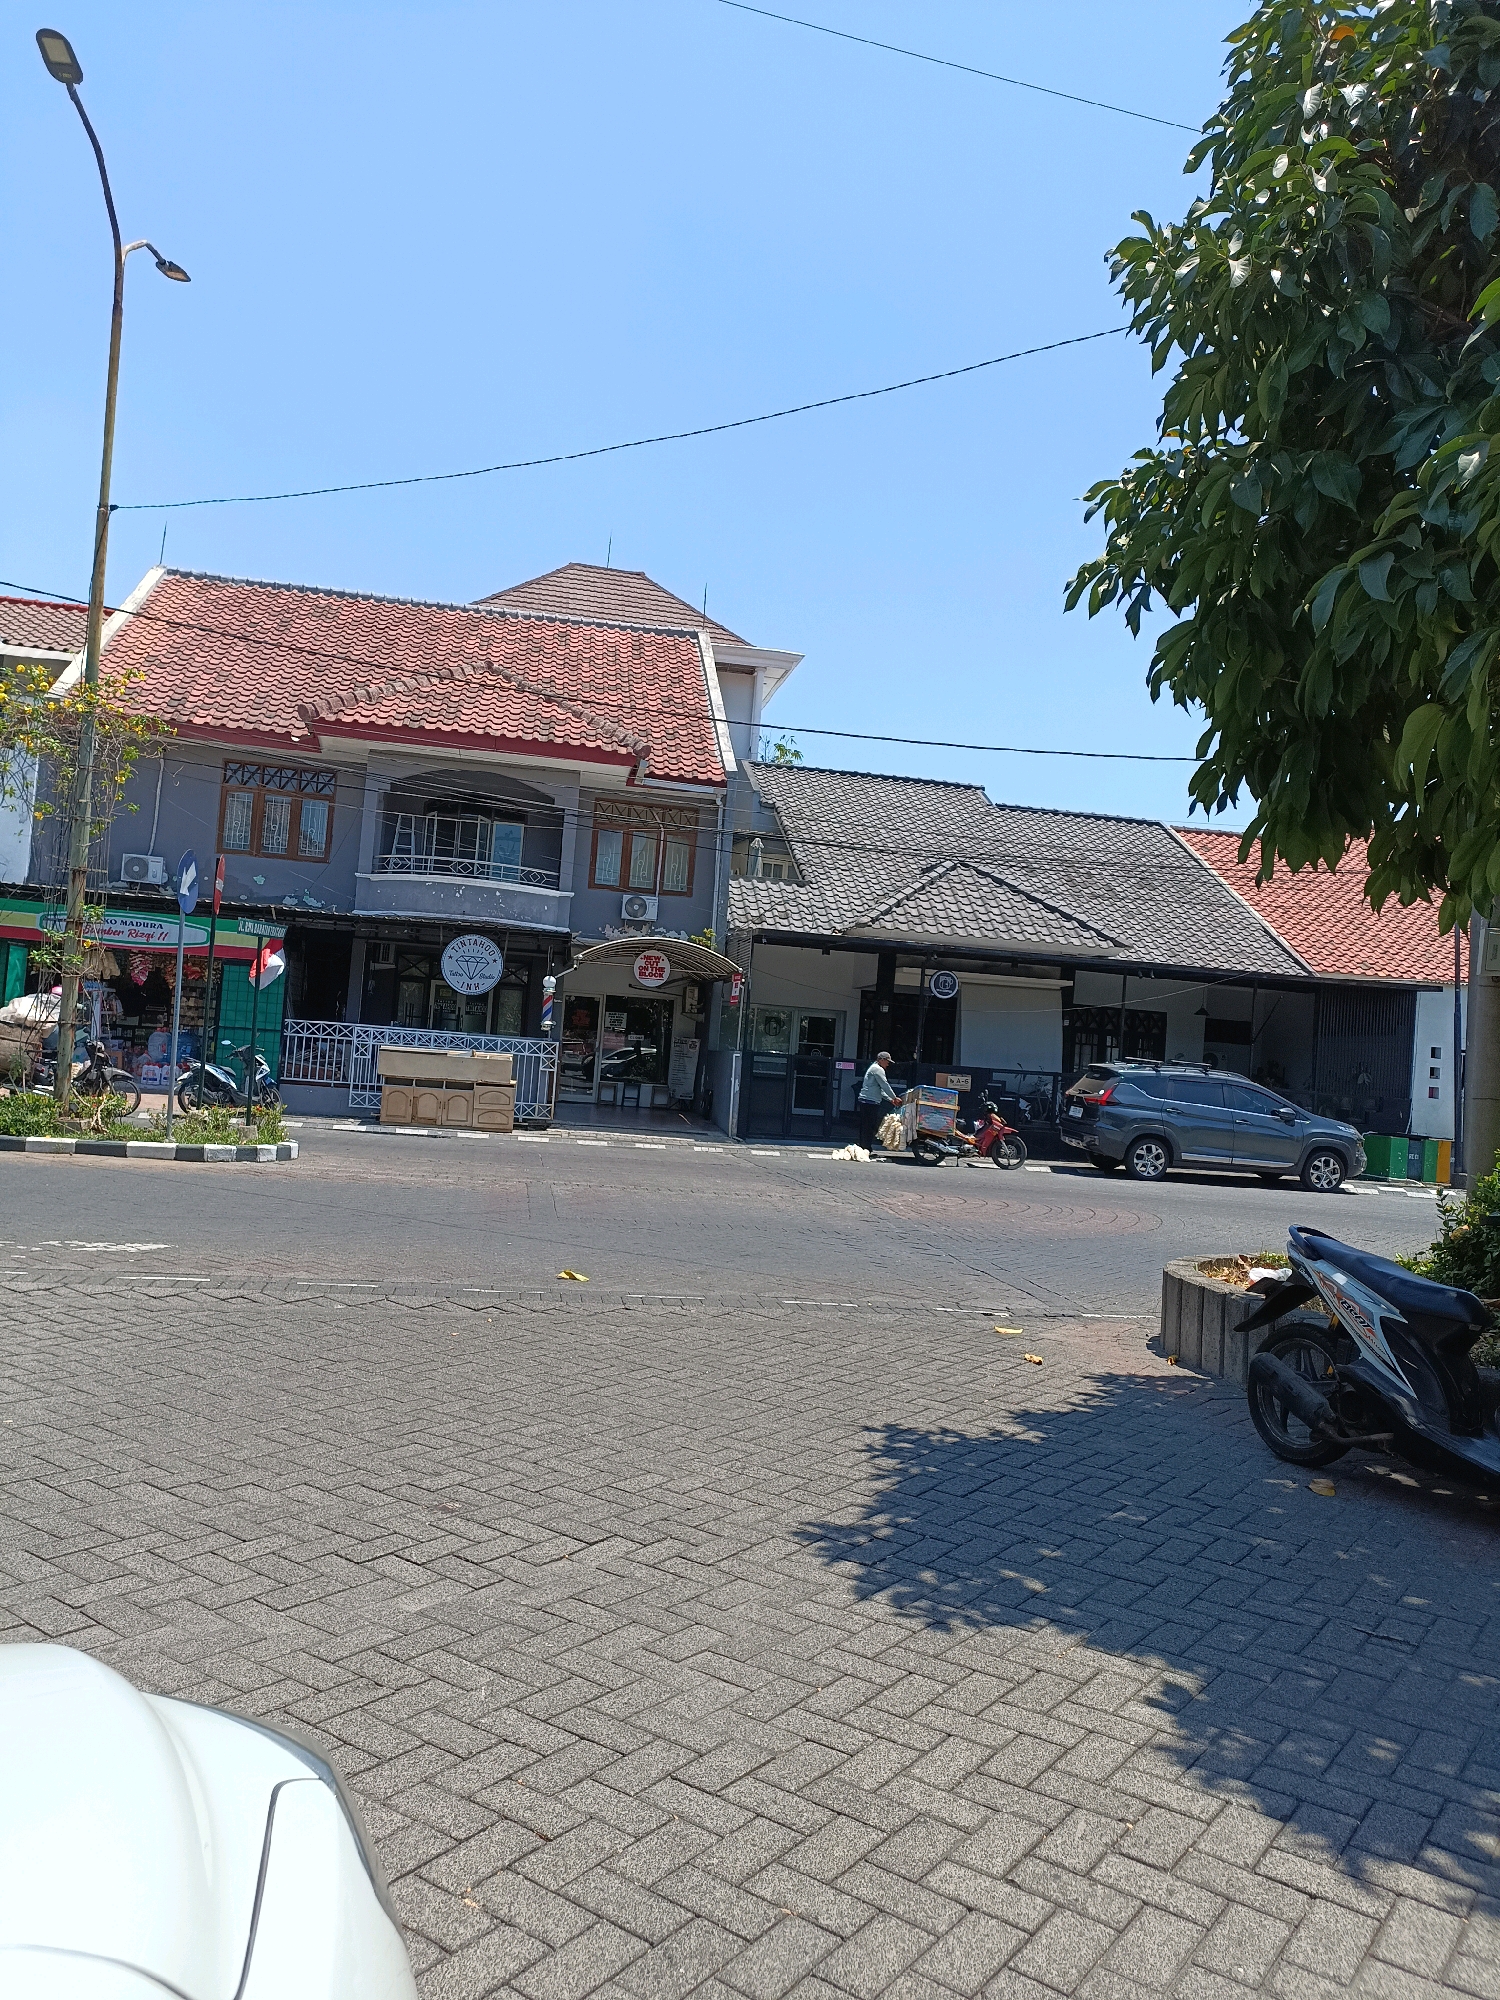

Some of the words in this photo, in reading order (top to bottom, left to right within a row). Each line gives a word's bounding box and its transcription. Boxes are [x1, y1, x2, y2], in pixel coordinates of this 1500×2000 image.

[120, 919, 164, 929] MADURA
[127, 928, 156, 942] Rizqi
[451, 938, 496, 957] TINTAHOO
